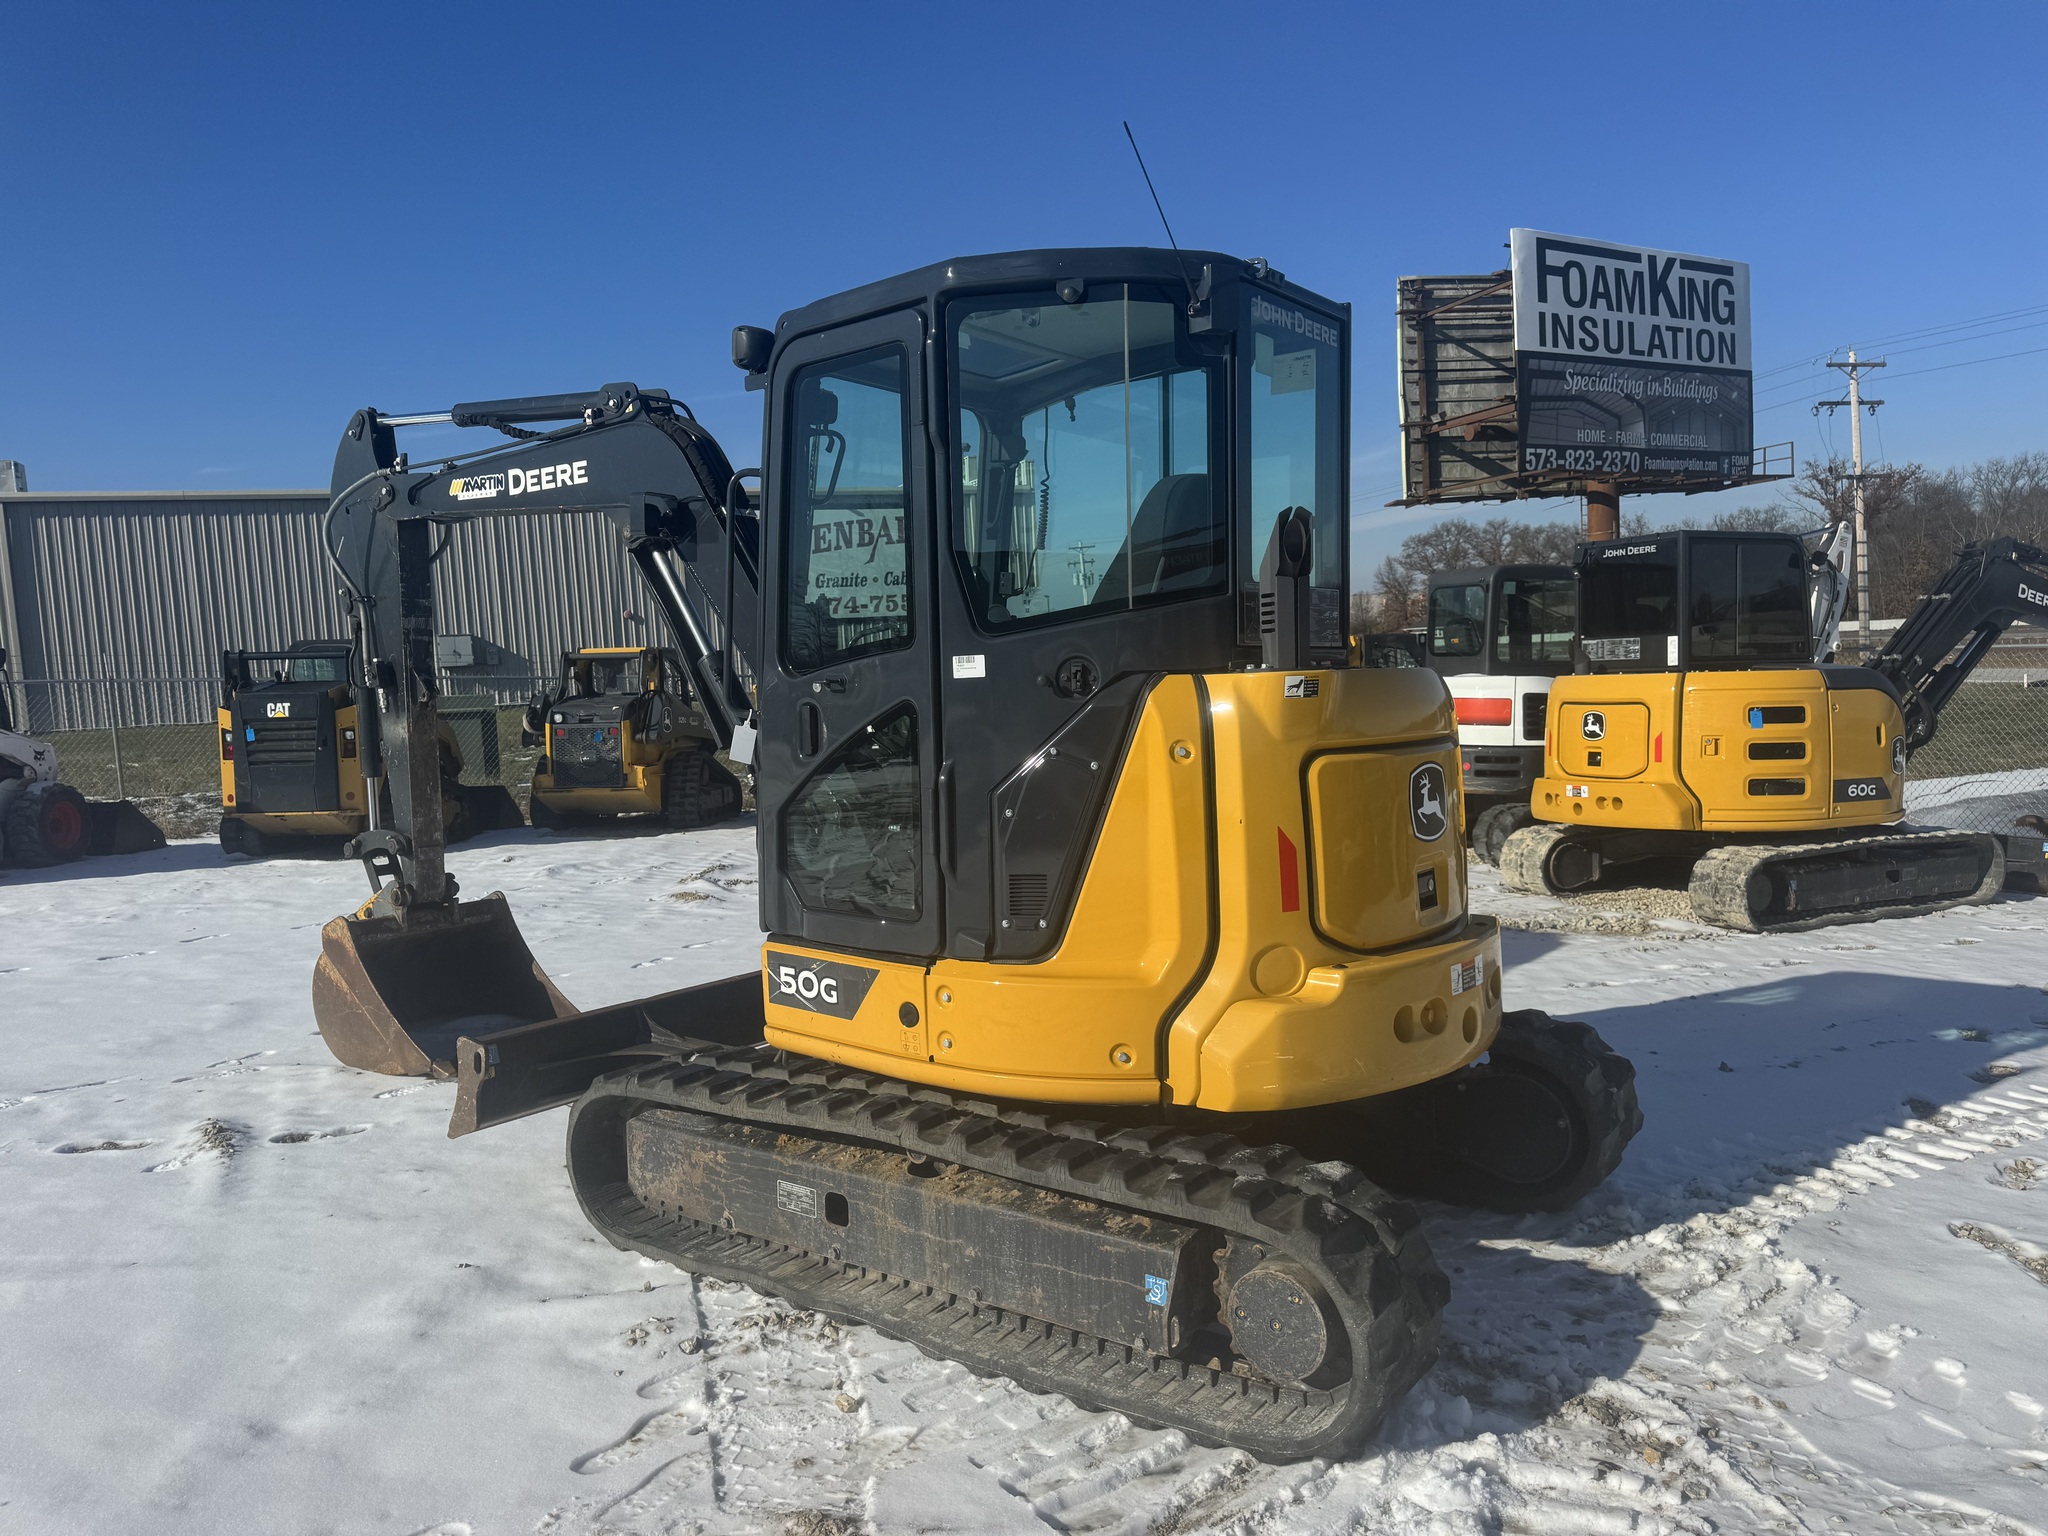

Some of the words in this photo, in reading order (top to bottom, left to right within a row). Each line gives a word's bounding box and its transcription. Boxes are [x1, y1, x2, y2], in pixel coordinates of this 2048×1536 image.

[1535, 237, 1736, 326] FOAMKING
[1252, 295, 1291, 330] JOHN
[1294, 310, 1338, 347] DEERE
[1538, 311, 1736, 365] INSULATION
[1563, 368, 1644, 399] Specializing
[1647, 375, 1660, 396] in
[1662, 376, 1719, 404] Buildings
[1577, 429, 1606, 444] HOME
[1615, 430, 1641, 446] FARM
[1650, 433, 1709, 448] COMMERCIAL
[1525, 448, 1640, 473] 573-823-2370
[1644, 456, 1718, 473] Foamkinginsulation.com
[1731, 455, 1750, 466] FOAM
[461, 474, 505, 493] MARTIN
[508, 459, 589, 496] DEERE
[1602, 548, 1626, 558] JOHN
[1627, 545, 1657, 555] DEERE
[815, 571, 868, 589] Granite
[266, 702, 291, 718] CAT
[1847, 783, 1877, 797] 60G
[779, 965, 838, 1004] 50G
